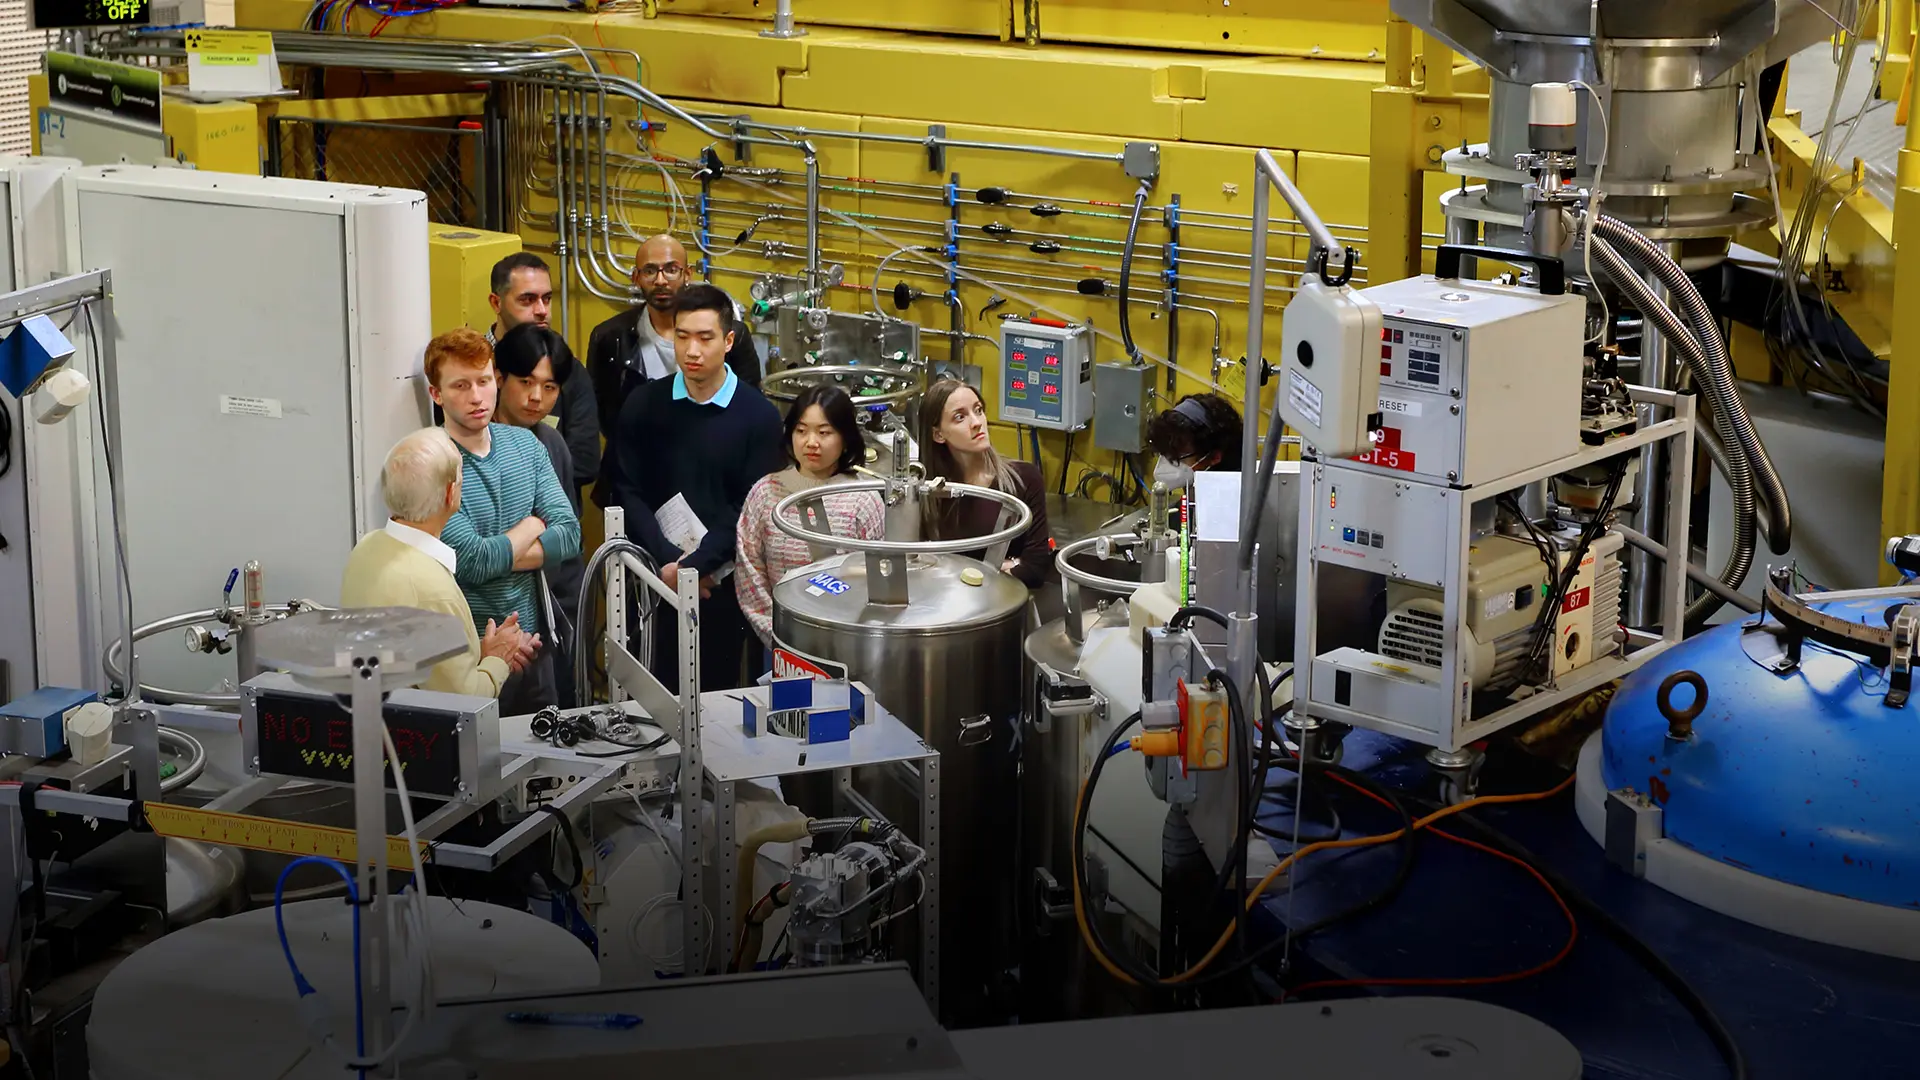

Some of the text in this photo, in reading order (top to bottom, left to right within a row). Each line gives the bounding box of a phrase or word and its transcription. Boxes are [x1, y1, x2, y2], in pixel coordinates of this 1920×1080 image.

[108, 5, 140, 19] OFF
[1379, 400, 1408, 411] RESET
[1360, 448, 1399, 468] BT-5
[809, 573, 850, 594] MACS
[1570, 592, 1581, 608] 87
[264, 712, 311, 743] NO
[328, 720, 439, 760] ERY
[154, 811, 191, 822] CAUTION
[207, 818, 245, 829] NEUTRON
[249, 823, 271, 834] BEAM
[277, 827, 298, 837] PATH
[313, 832, 346, 844] SURVEY
